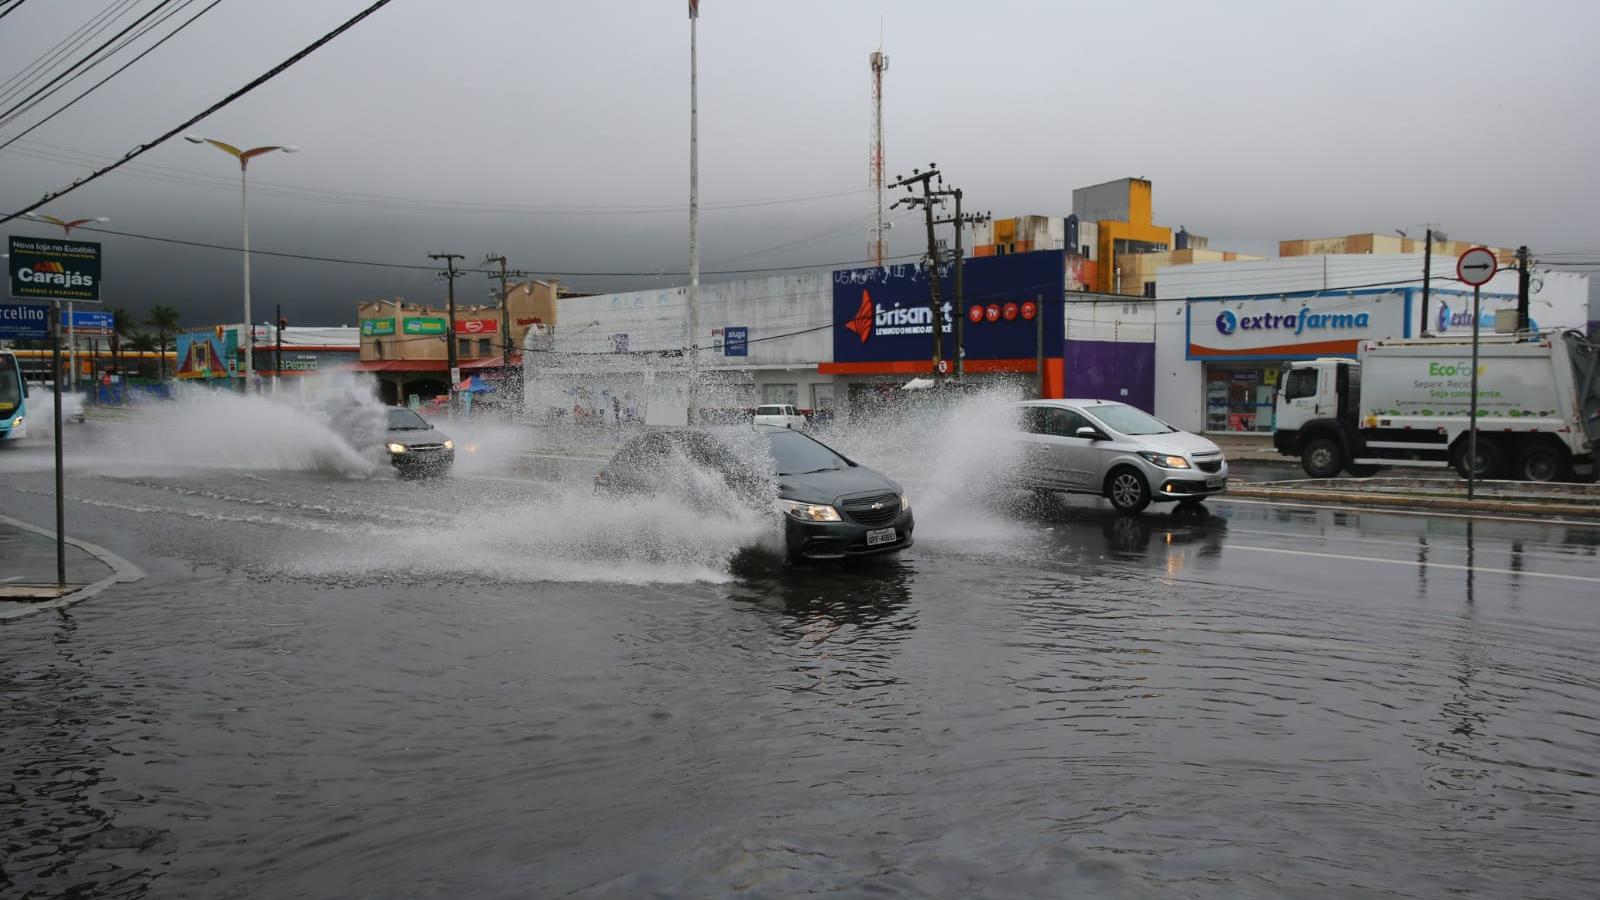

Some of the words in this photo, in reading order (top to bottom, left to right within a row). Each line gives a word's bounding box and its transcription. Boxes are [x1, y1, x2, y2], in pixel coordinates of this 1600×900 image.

[13, 241, 34, 249] Nova
[36, 243, 51, 251] loja
[18, 267, 93, 287] Carajás
[876, 302, 953, 326] brisant
[1240, 307, 1369, 335] extrafarma
